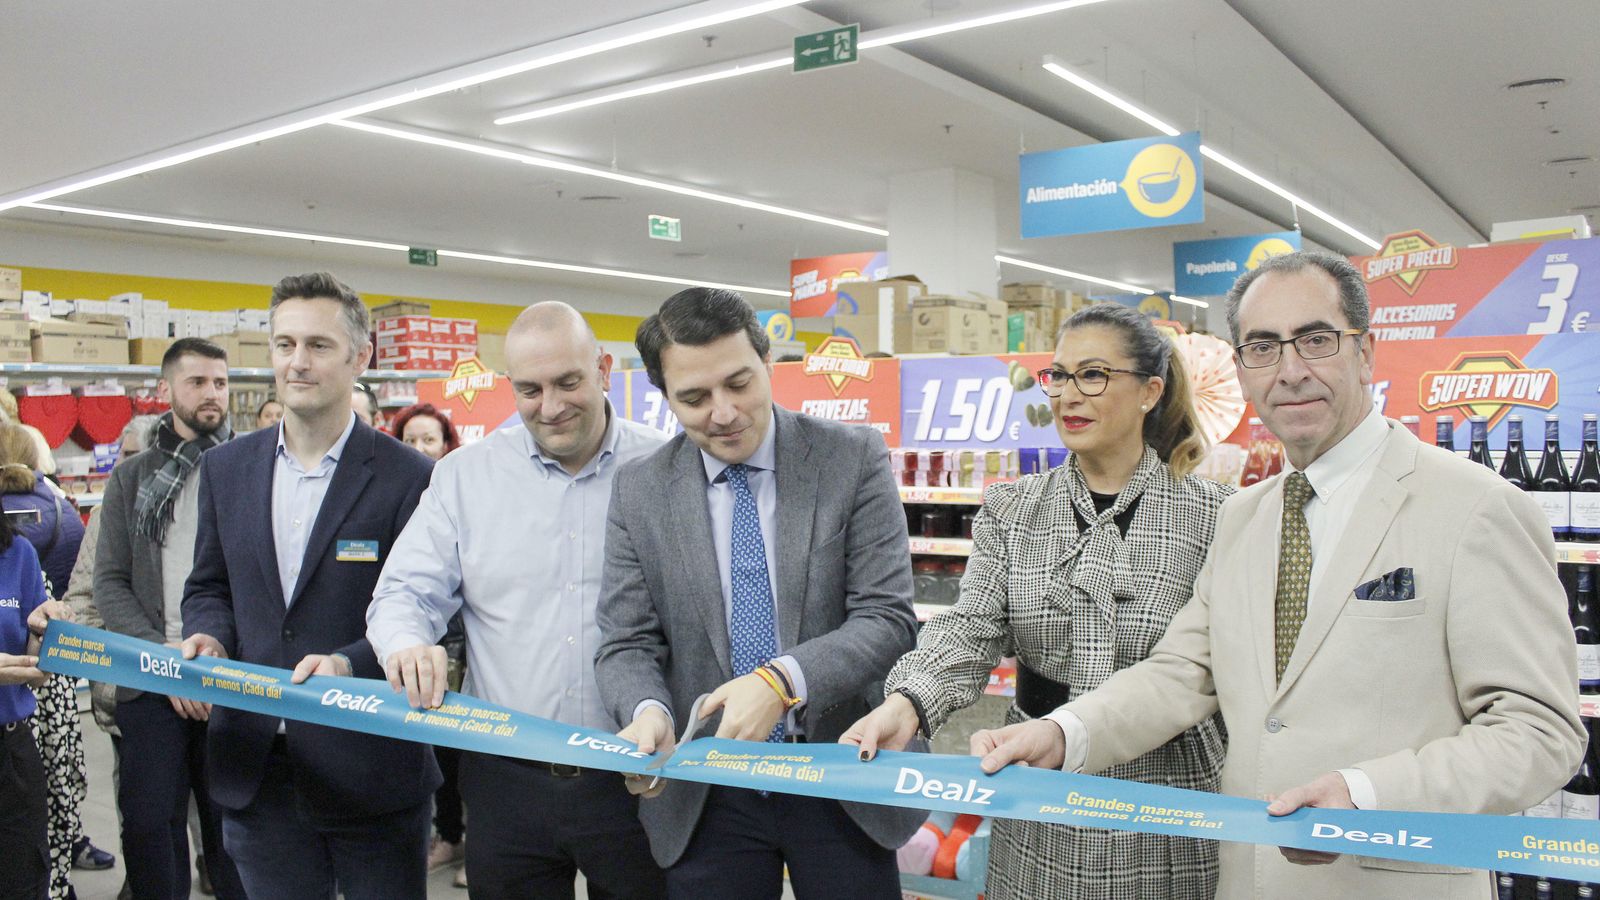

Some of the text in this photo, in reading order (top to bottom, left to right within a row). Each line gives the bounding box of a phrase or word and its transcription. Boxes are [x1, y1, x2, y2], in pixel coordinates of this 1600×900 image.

[1026, 178, 1117, 204] Alimentación
[1366, 246, 1452, 280] SUPER PRECIO
[1526, 263, 1590, 335] 3 €
[1371, 303, 1457, 324] ACCESORIOS
[806, 355, 836, 373] SUPER
[445, 377, 468, 399] SUPER
[1427, 372, 1551, 405] SUPER WOW
[801, 399, 869, 421] CERVEZAS
[914, 376, 1021, 442] 1.50 €
[0, 596, 20, 609] ealz
[58, 632, 105, 653] Grandes marcas
[47, 647, 59, 658] por
[59, 649, 80, 661] menos
[80, 652, 99, 665] ¡Cada
[139, 651, 183, 680] Dealz
[202, 675, 214, 688] por
[215, 678, 241, 692] menos
[242, 681, 265, 696] ¡Cada
[321, 688, 385, 714] Dealz
[404, 711, 425, 724] por
[424, 714, 461, 729] menos
[459, 719, 493, 734] ¡Cada
[470, 708, 512, 722] marcas
[706, 749, 761, 762] Grandes
[703, 760, 750, 772] menos
[751, 761, 793, 779] ¡Cada
[795, 766, 826, 783] día!
[893, 767, 996, 805] Dealz
[1066, 791, 1206, 820] Grandes marcas
[1039, 806, 1225, 830] por menos ¡Cada día!
[1311, 823, 1433, 849] Dealz
[1497, 849, 1533, 860] por
